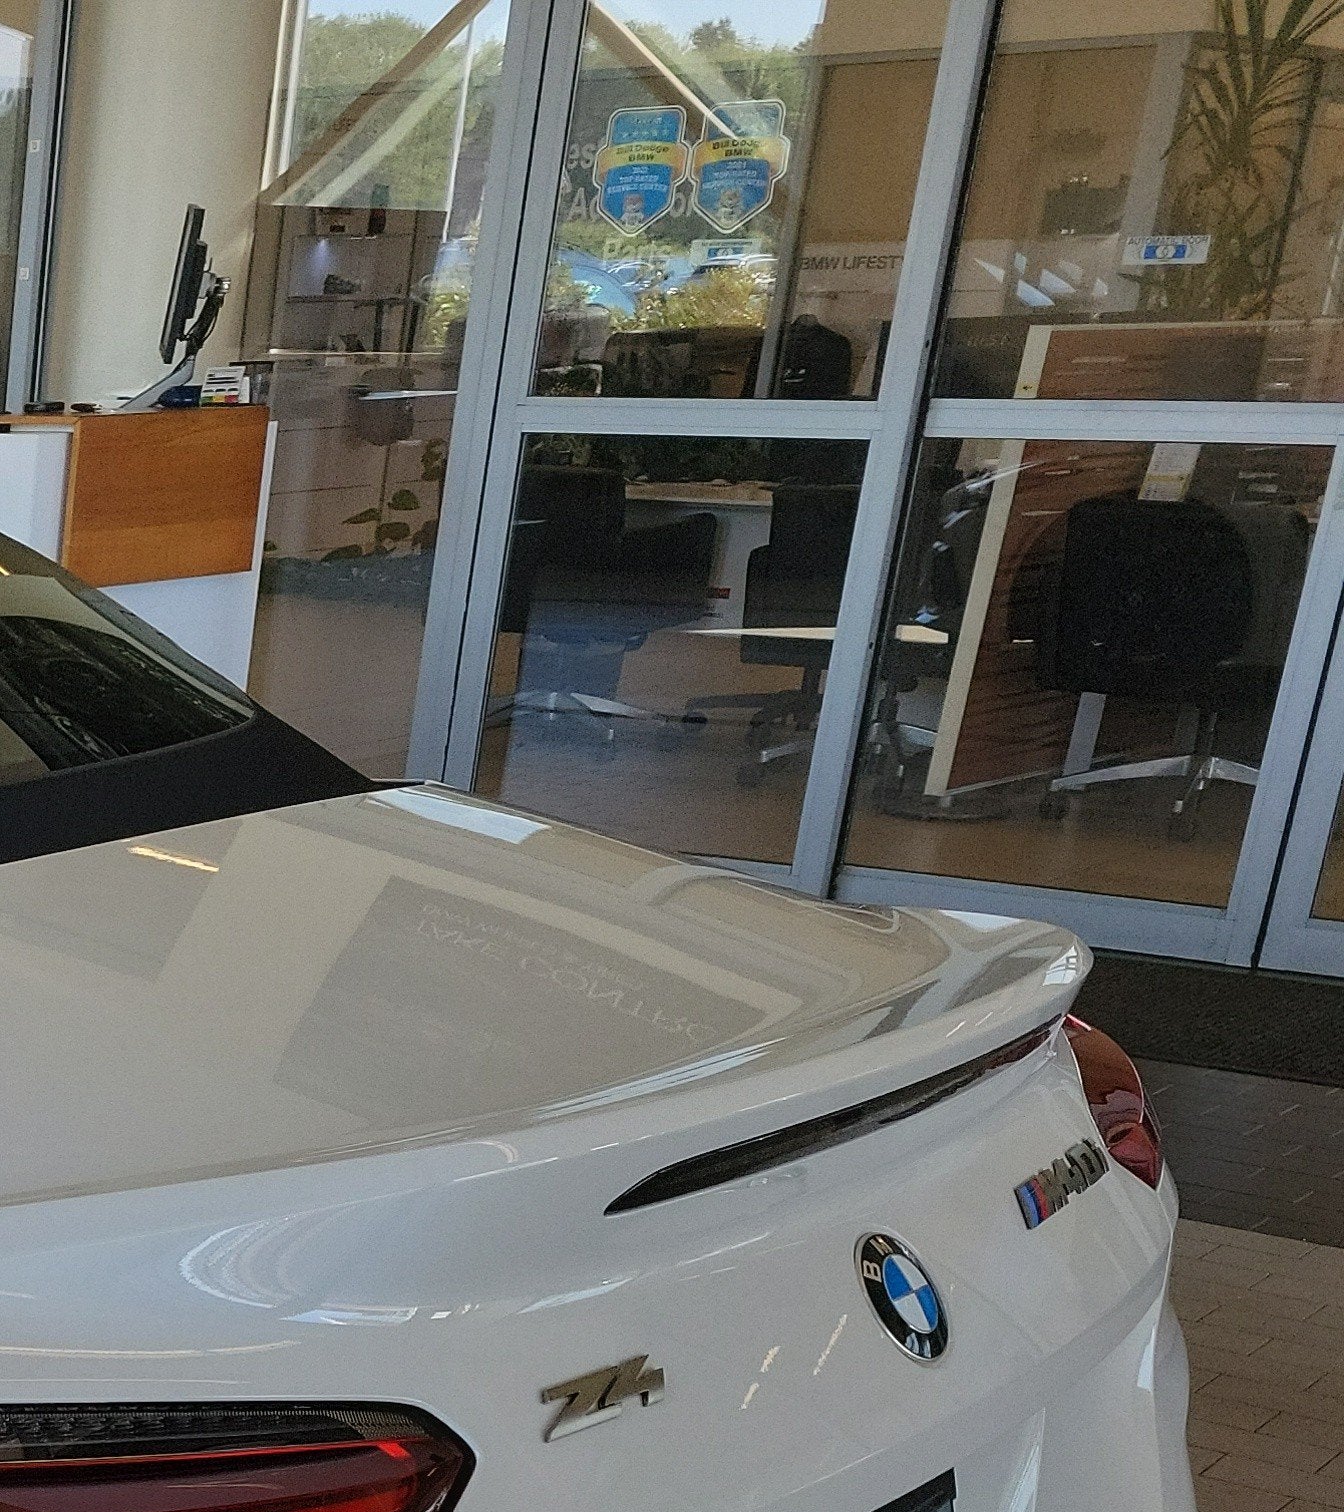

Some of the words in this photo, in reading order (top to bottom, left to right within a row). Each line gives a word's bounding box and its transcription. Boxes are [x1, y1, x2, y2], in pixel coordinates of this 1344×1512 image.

[627, 153, 655, 162] BMW
[799, 256, 840, 270] BMW
[541, 1354, 666, 1443] Z4
